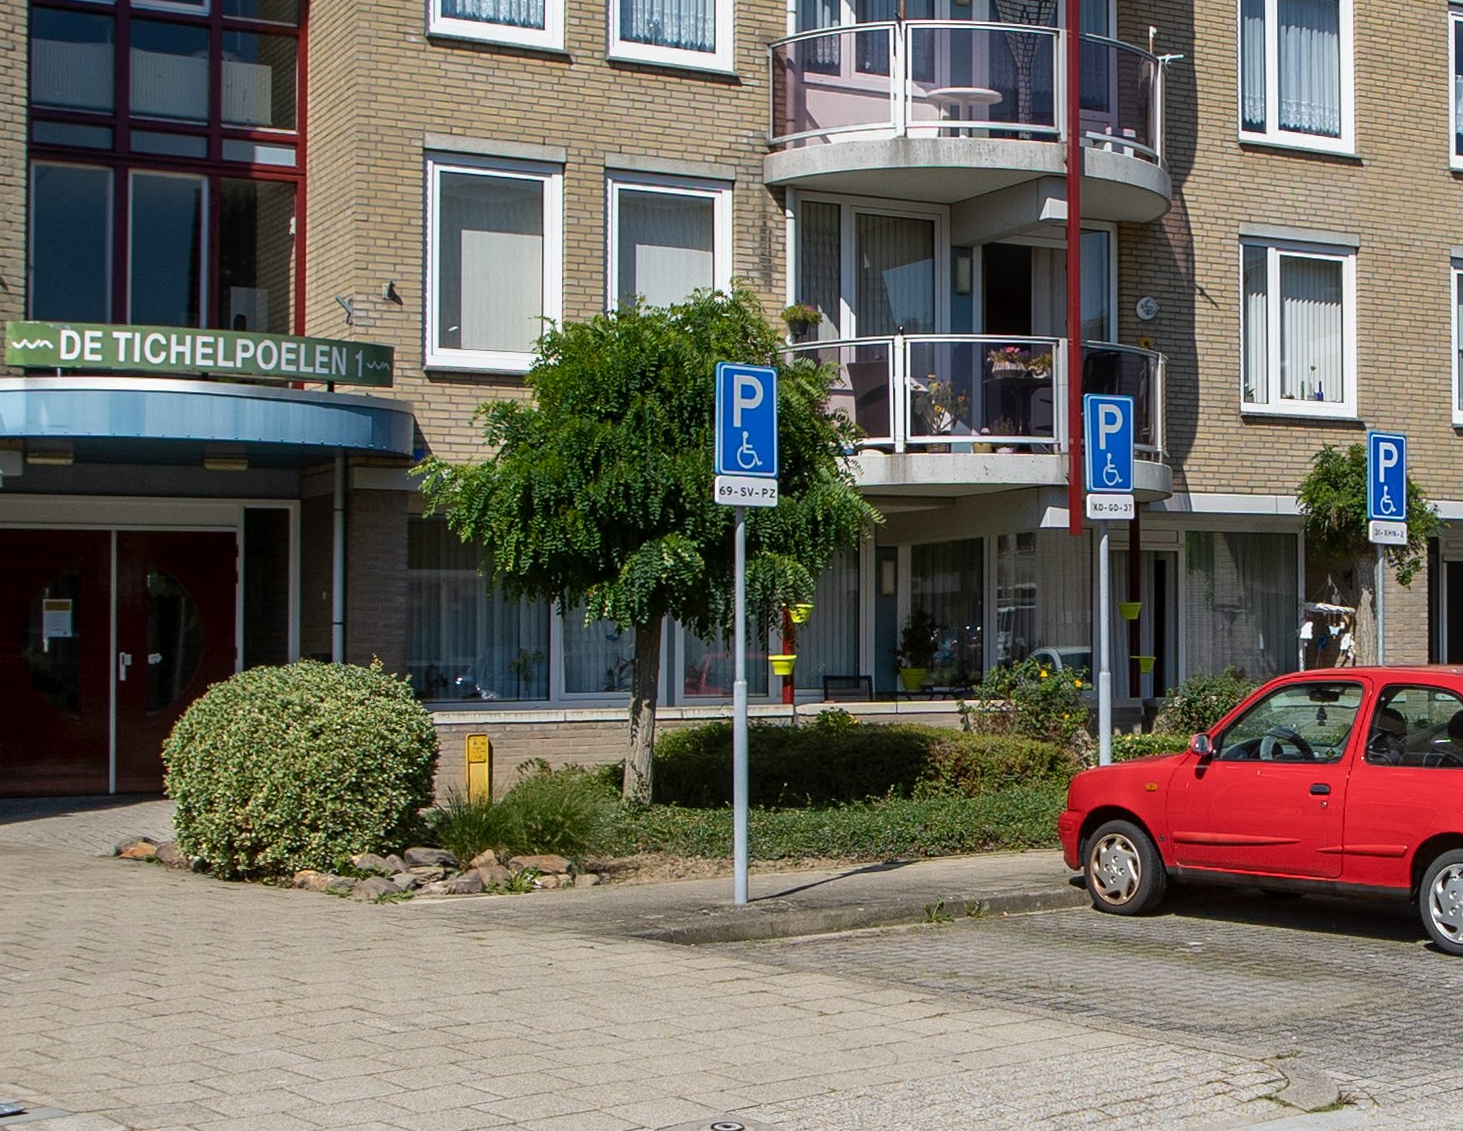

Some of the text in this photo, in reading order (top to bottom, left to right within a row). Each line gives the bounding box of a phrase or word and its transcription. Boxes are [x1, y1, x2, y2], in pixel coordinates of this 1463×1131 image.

[59, 328, 363, 377] DE TICHELPOELEN 1
[733, 374, 763, 427] P
[1098, 404, 1123, 449] P
[1379, 442, 1398, 483] P
[719, 486, 775, 498] 69-SV-PZ
